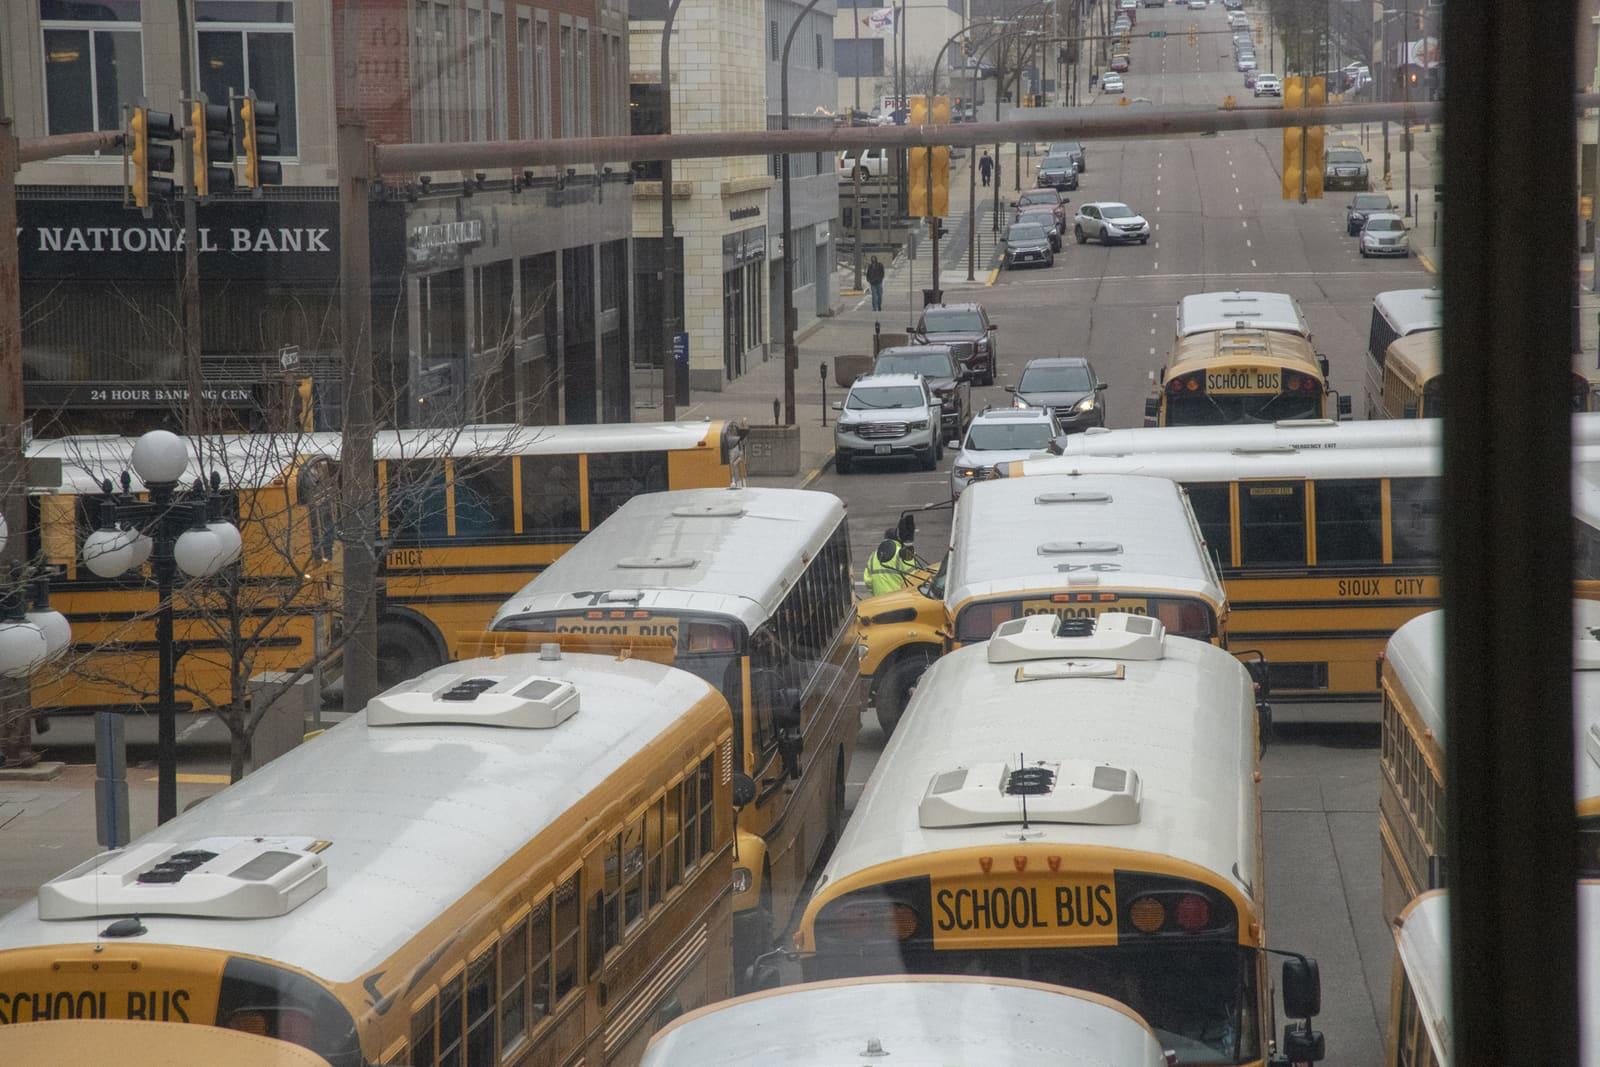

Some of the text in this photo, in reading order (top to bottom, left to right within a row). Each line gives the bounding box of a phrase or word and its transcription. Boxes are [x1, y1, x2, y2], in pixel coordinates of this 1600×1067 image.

[37, 227, 218, 252] NATIONAL
[230, 228, 331, 252] BANK
[1208, 373, 1279, 390] SCHOOL BUS
[91, 389, 251, 401] 24 HOUR BANKNG CEN
[388, 550, 424, 565] TRICT
[1338, 579, 1424, 596] SIOUX CITY
[937, 884, 1113, 931] SCHOOL BUS
